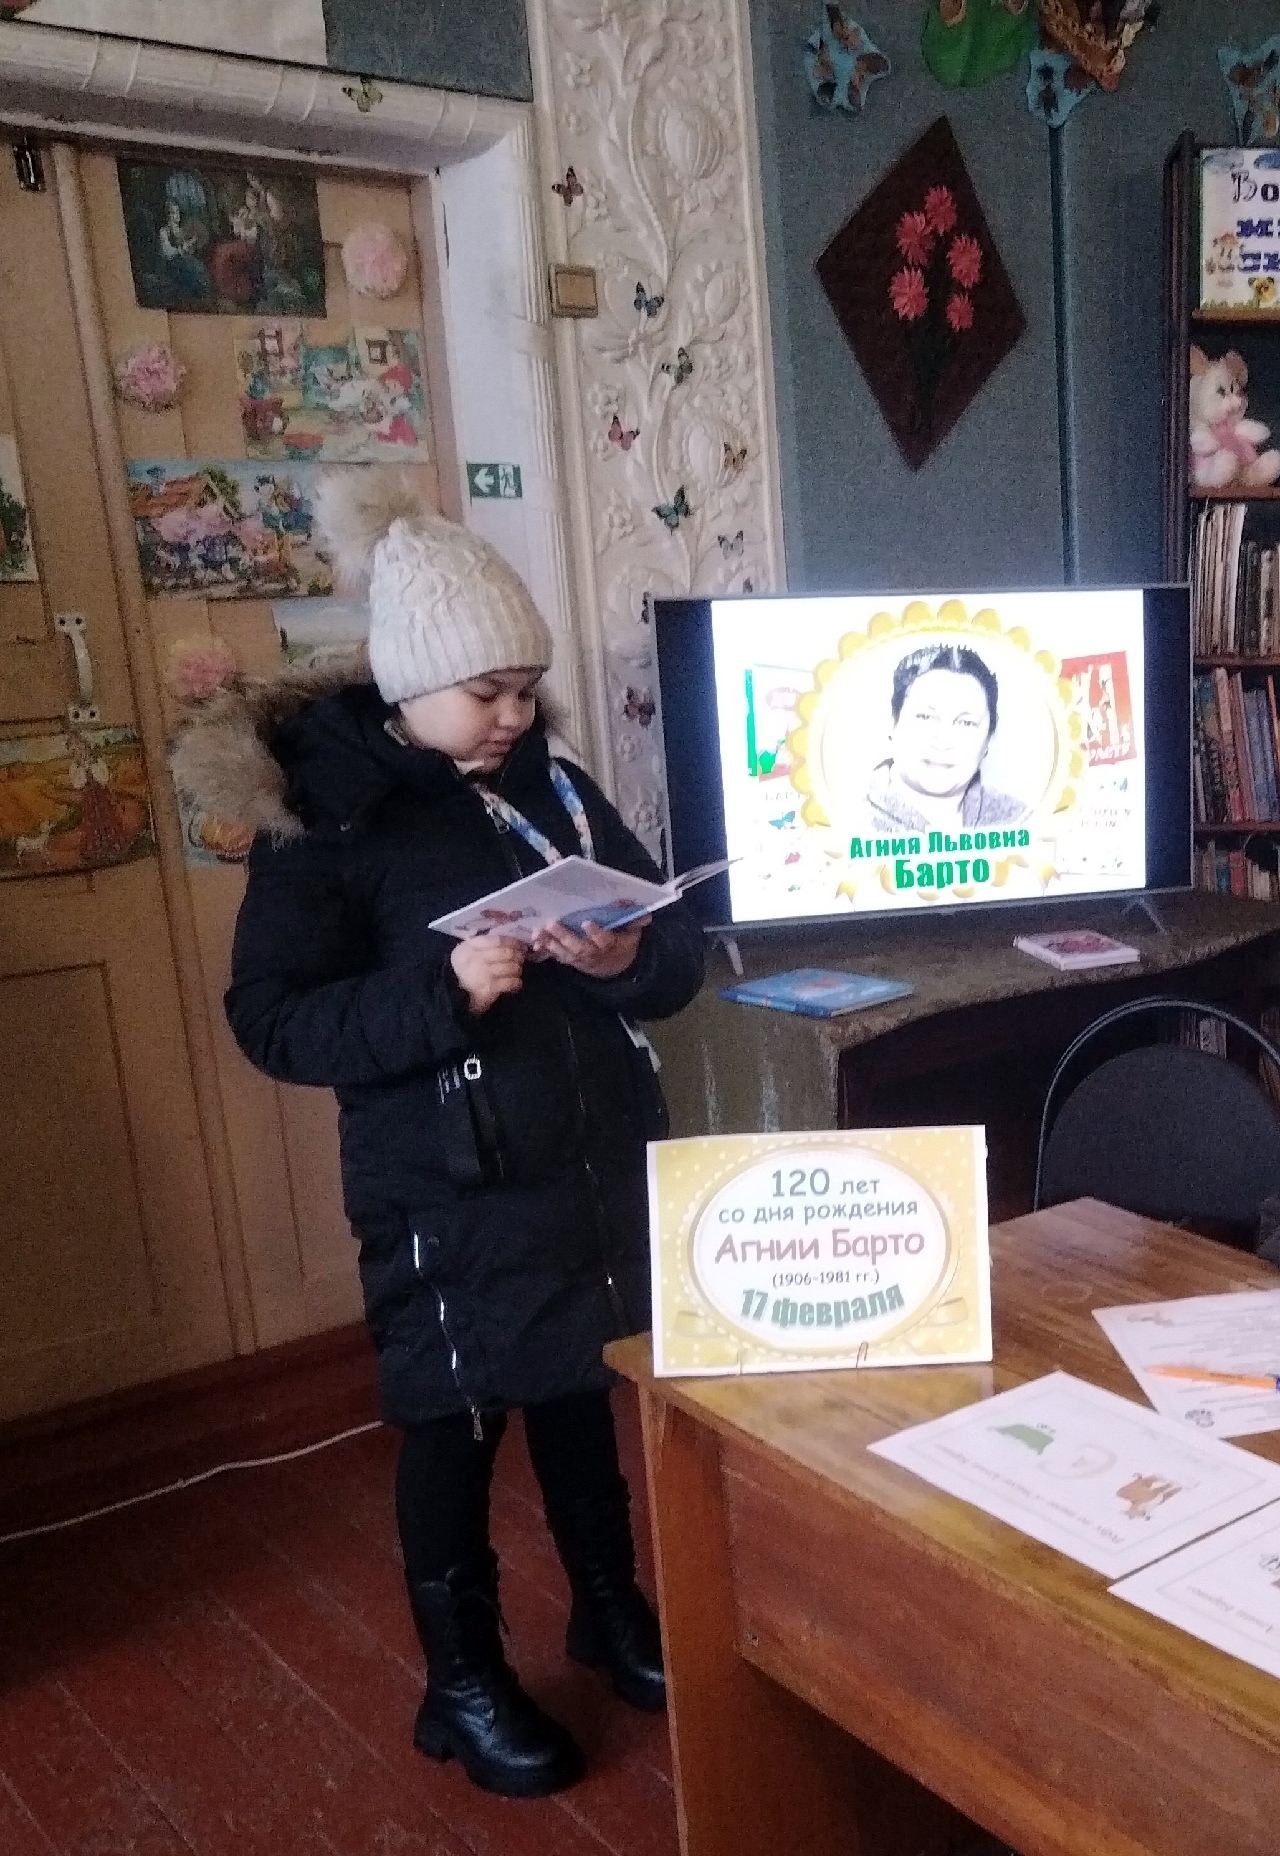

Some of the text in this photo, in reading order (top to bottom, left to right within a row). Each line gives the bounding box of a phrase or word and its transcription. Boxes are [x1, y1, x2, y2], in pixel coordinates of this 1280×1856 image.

[850, 829, 1031, 859] Агния Львовна
[894, 858, 991, 890] Барто
[772, 1168, 881, 1198] 120 лет
[718, 1200, 918, 1225] со дня рождения
[714, 1228, 925, 1265] Агнии Барто
[772, 1270, 851, 1288] (1906-1981
[740, 1284, 905, 1327] 17 февраля
